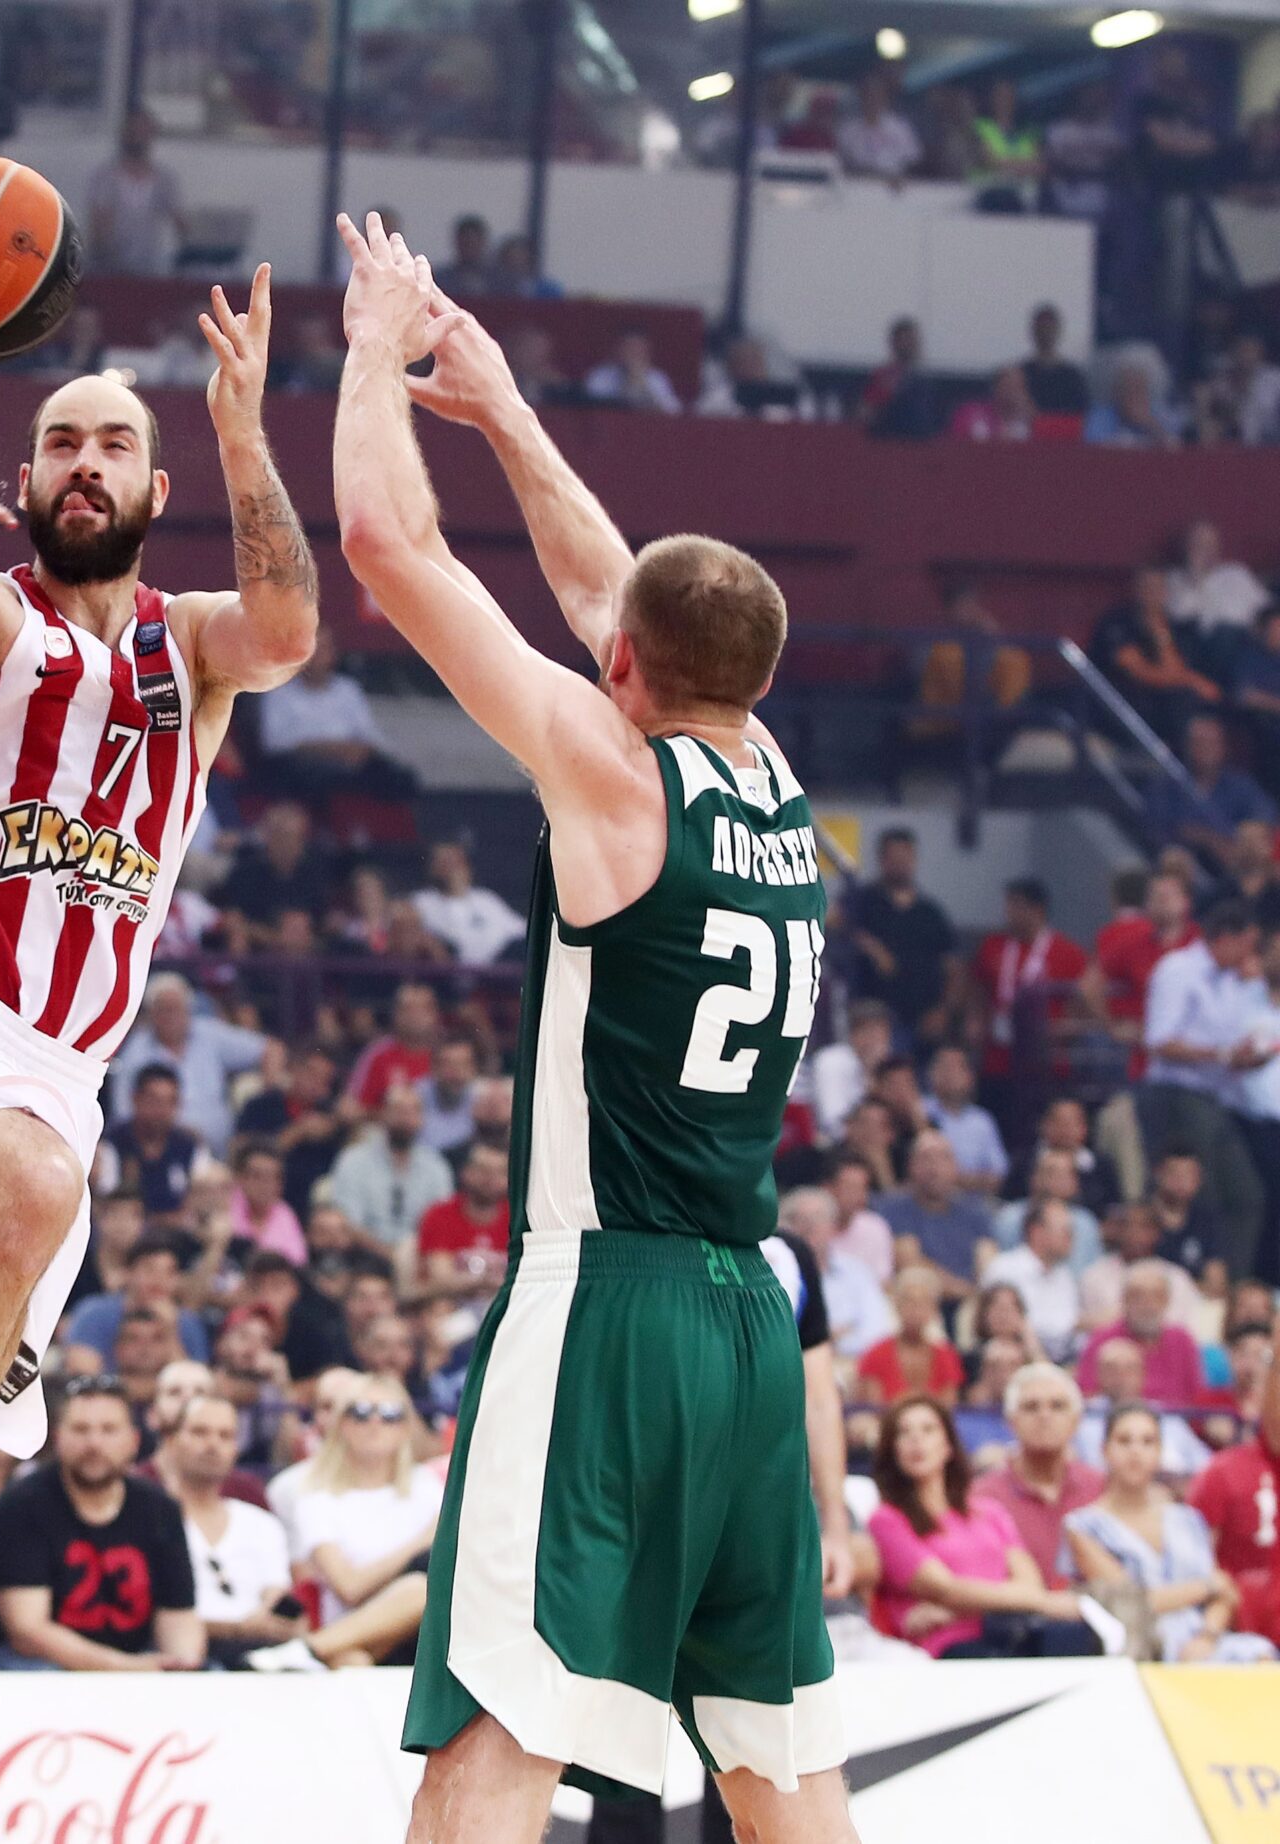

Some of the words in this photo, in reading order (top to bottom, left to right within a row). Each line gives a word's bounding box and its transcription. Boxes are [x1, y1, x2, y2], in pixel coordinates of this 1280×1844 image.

[97, 723, 142, 800] 7
[679, 907, 826, 1097] 24
[58, 1540, 152, 1632] 23
